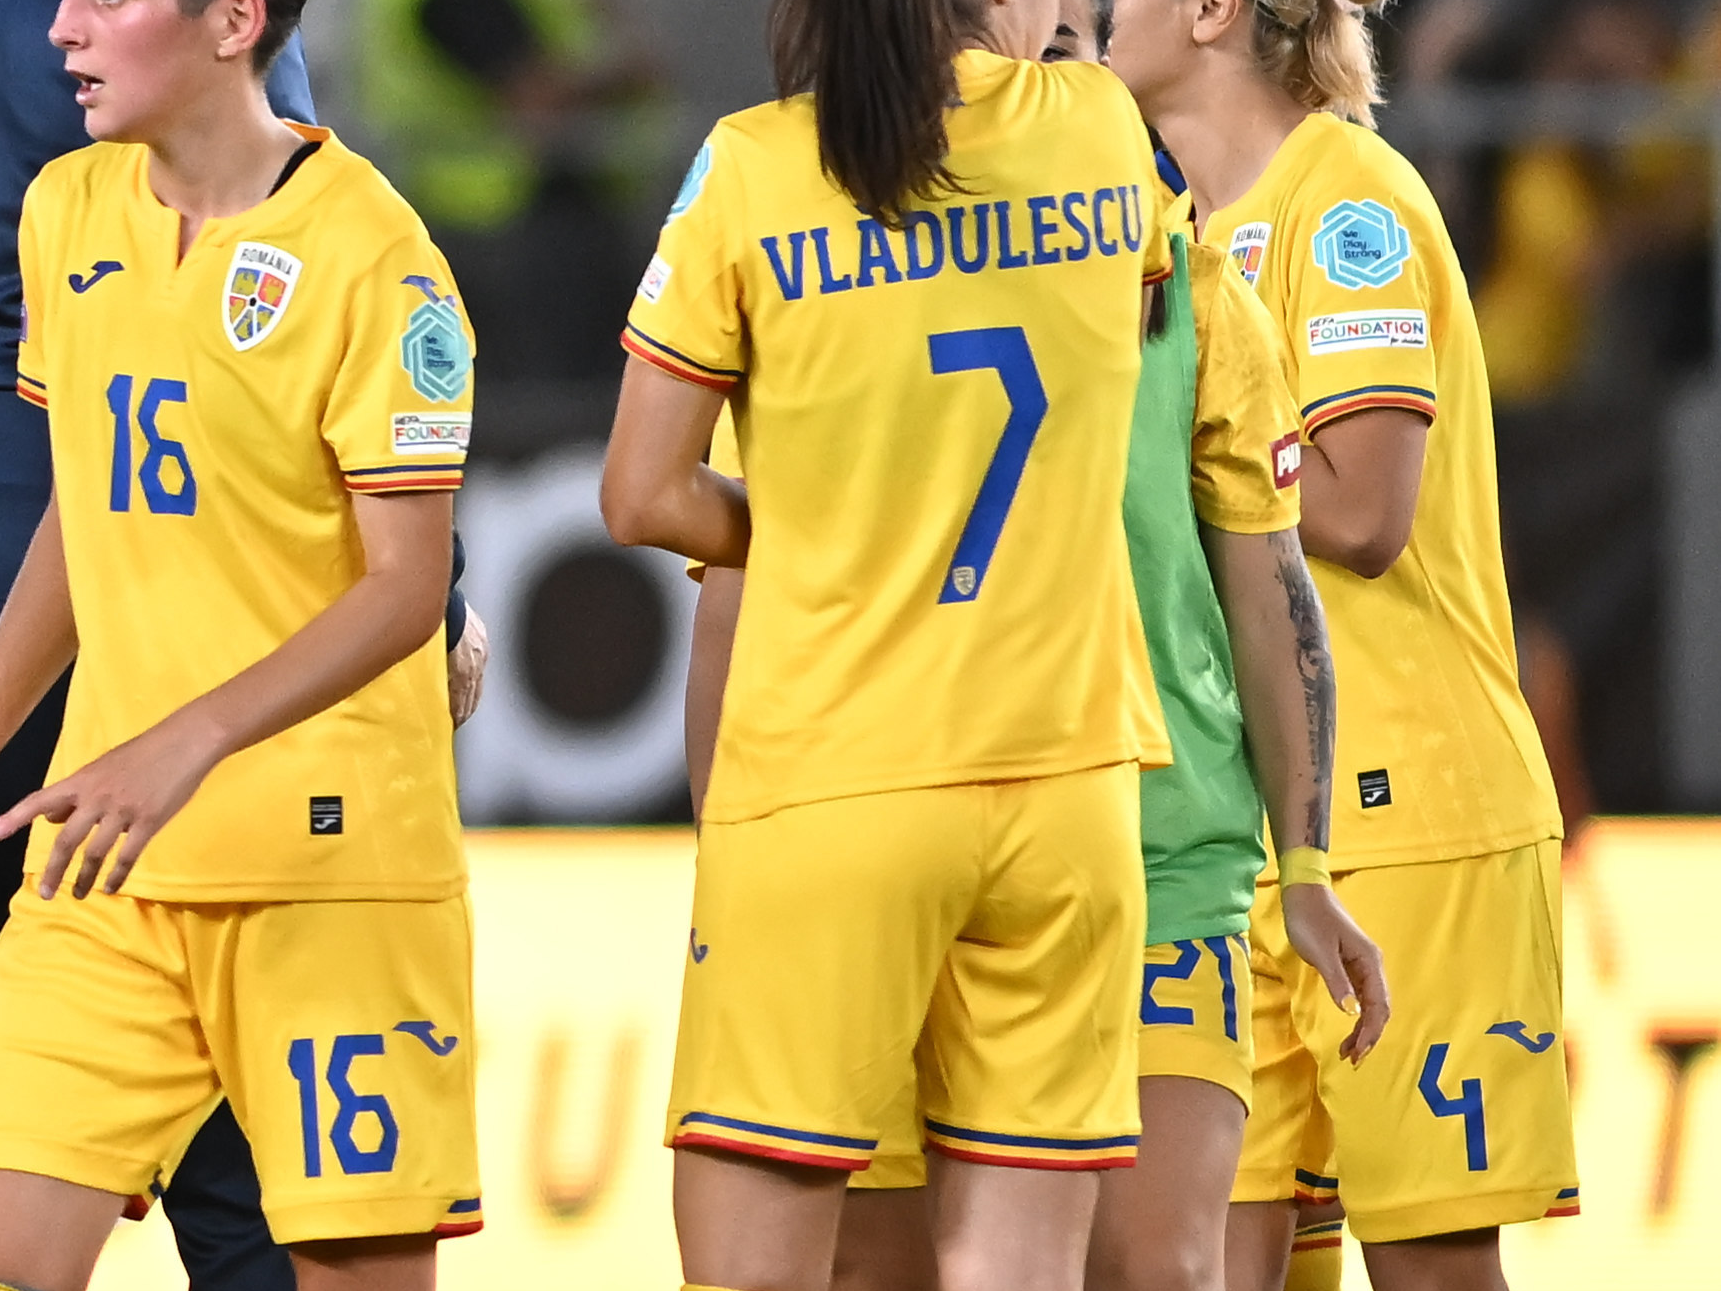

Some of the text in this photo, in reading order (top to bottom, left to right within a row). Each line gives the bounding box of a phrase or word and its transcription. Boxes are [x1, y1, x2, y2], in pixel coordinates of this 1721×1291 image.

[761, 184, 1143, 301] VLADULESCU
[1344, 250, 1382, 260] Strong
[1310, 321, 1424, 342] FOUNDATION
[106, 374, 197, 516] 16
[927, 326, 1049, 604] 7
[287, 1034, 399, 1178] 16
[1418, 1043, 1488, 1172] 4
